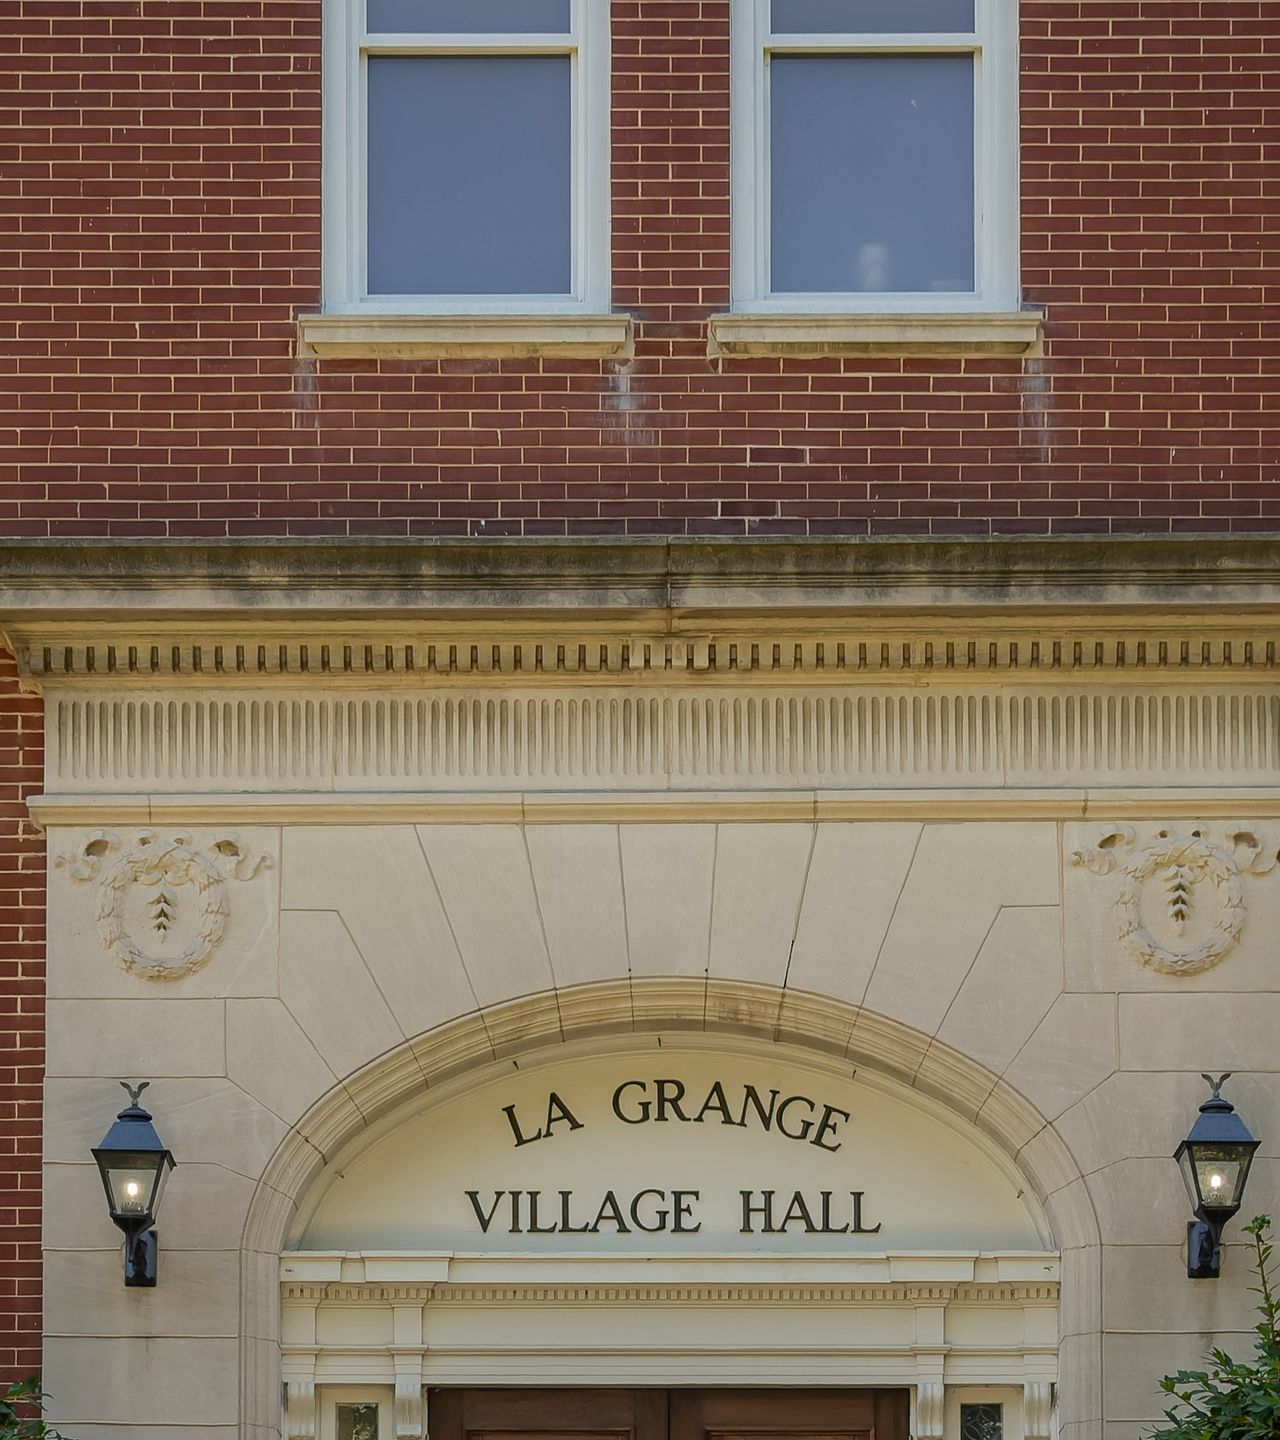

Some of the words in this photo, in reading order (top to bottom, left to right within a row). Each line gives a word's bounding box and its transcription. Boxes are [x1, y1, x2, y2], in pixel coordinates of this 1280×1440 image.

[501, 1091, 584, 1147] LA
[612, 1079, 851, 1152] GRANGE
[465, 1189, 702, 1234] VILLAGE
[740, 1190, 882, 1234] HALL
